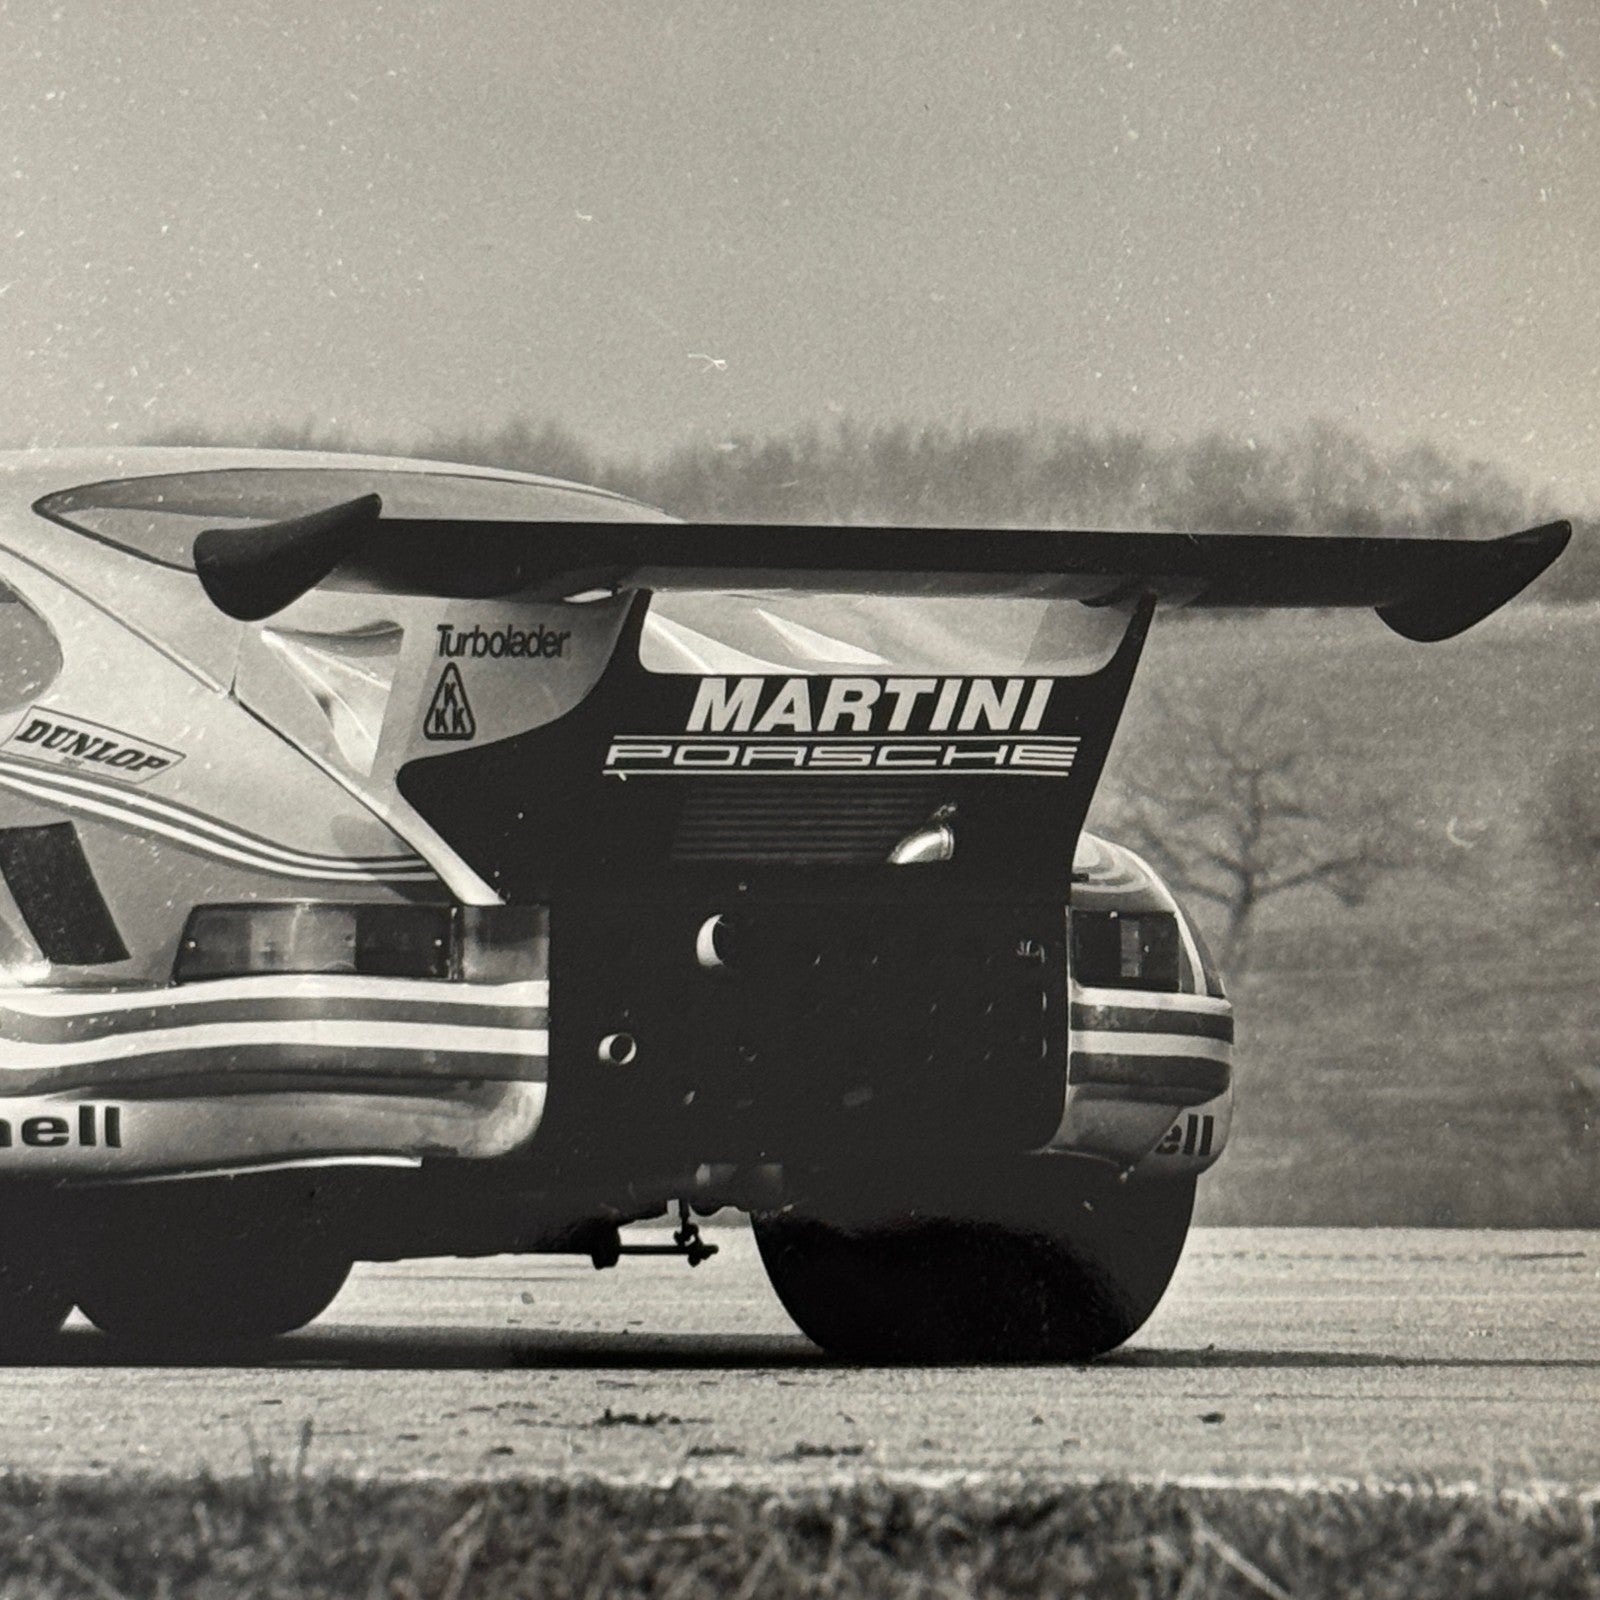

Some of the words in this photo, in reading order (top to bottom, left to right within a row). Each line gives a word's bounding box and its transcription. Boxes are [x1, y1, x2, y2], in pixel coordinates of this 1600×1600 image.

[437, 624, 571, 658] Turbolader
[685, 678, 1055, 732] MARTINI
[14, 719, 171, 771] DUNLOP
[604, 744, 1079, 768] PORSCHE
[0, 1104, 122, 1149] ell
